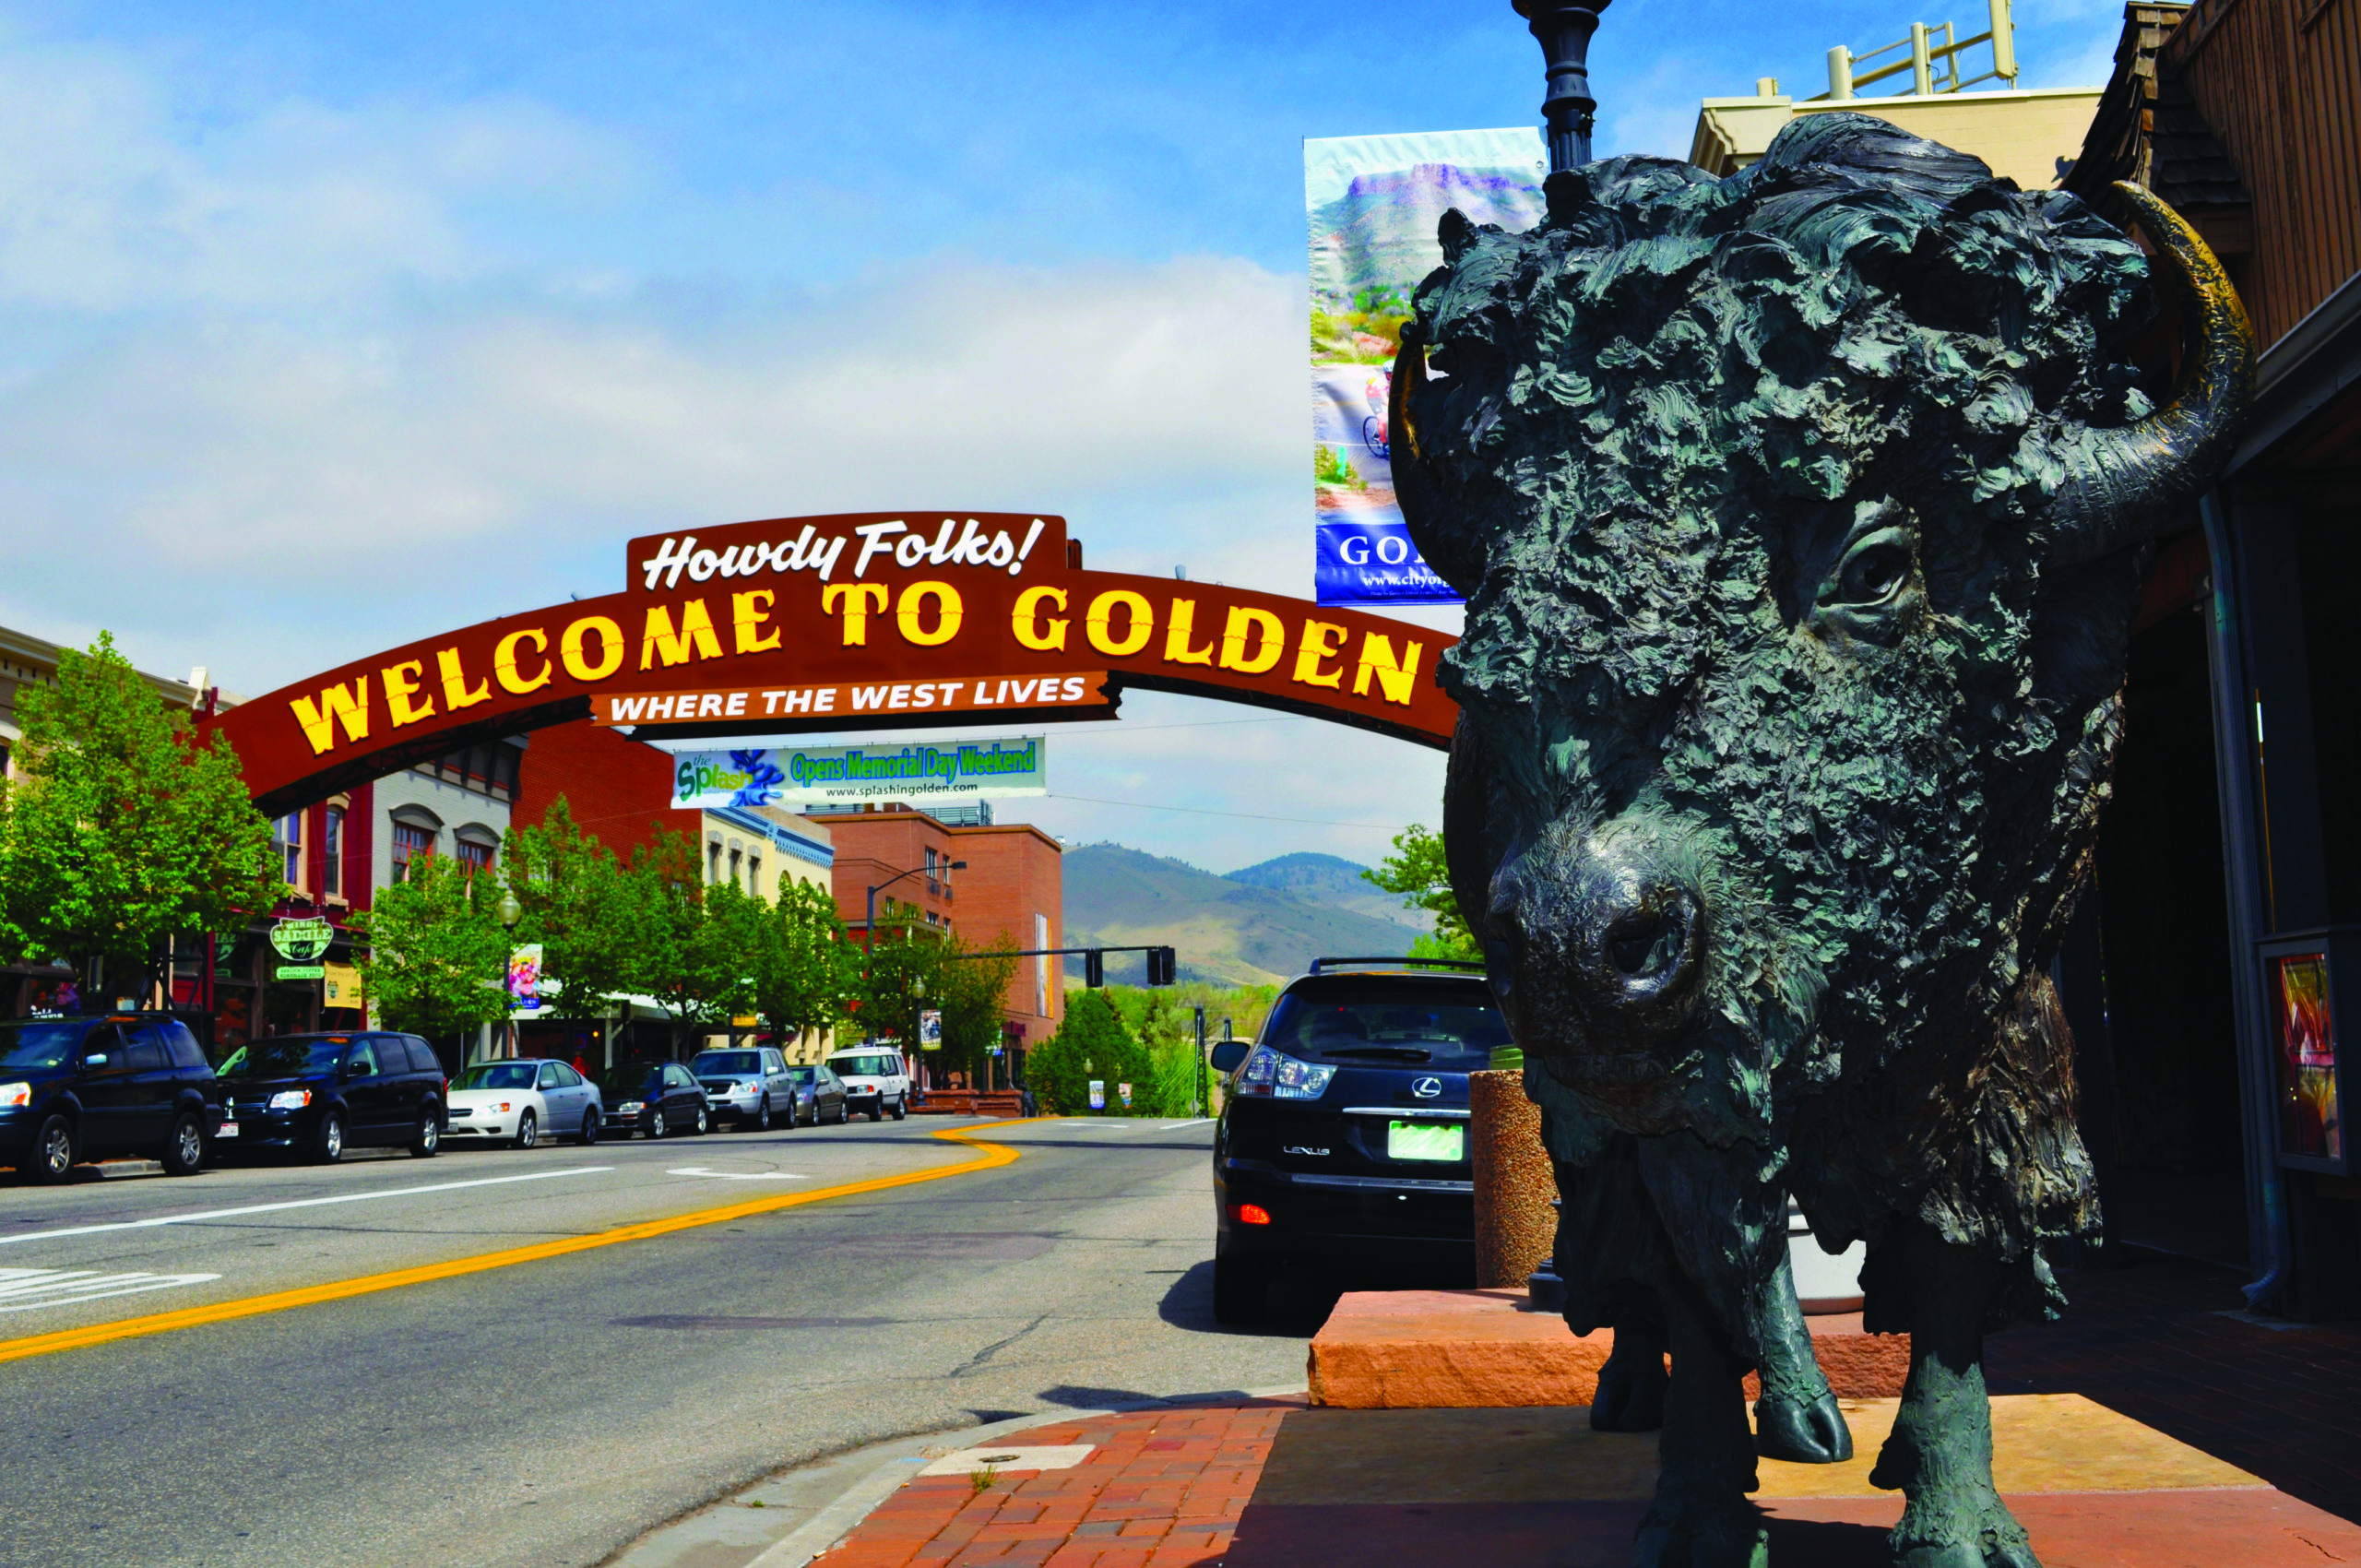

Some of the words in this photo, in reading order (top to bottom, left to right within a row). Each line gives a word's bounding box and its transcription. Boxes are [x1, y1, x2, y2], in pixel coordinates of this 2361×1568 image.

[643, 526, 846, 589] Howdy
[854, 519, 1046, 578] Folks!
[1340, 536, 1425, 564] GO
[290, 589, 781, 754] WELCOME
[823, 581, 963, 645] TO
[1012, 587, 1423, 706] GOLDEN
[611, 693, 748, 721] WHERE
[762, 689, 836, 715] THE
[852, 683, 963, 710] WEST
[974, 678, 1085, 705] LIVES
[694, 754, 711, 766] the
[791, 753, 845, 788] Opens
[846, 747, 923, 780] Memorial
[925, 747, 958, 784] Day
[958, 742, 1036, 776] Weekend
[678, 761, 754, 802] Splash
[825, 782, 979, 798] www.splashingolden.com
[274, 929, 331, 942] SADDLE
[1283, 1146, 1330, 1156] LEXUS
